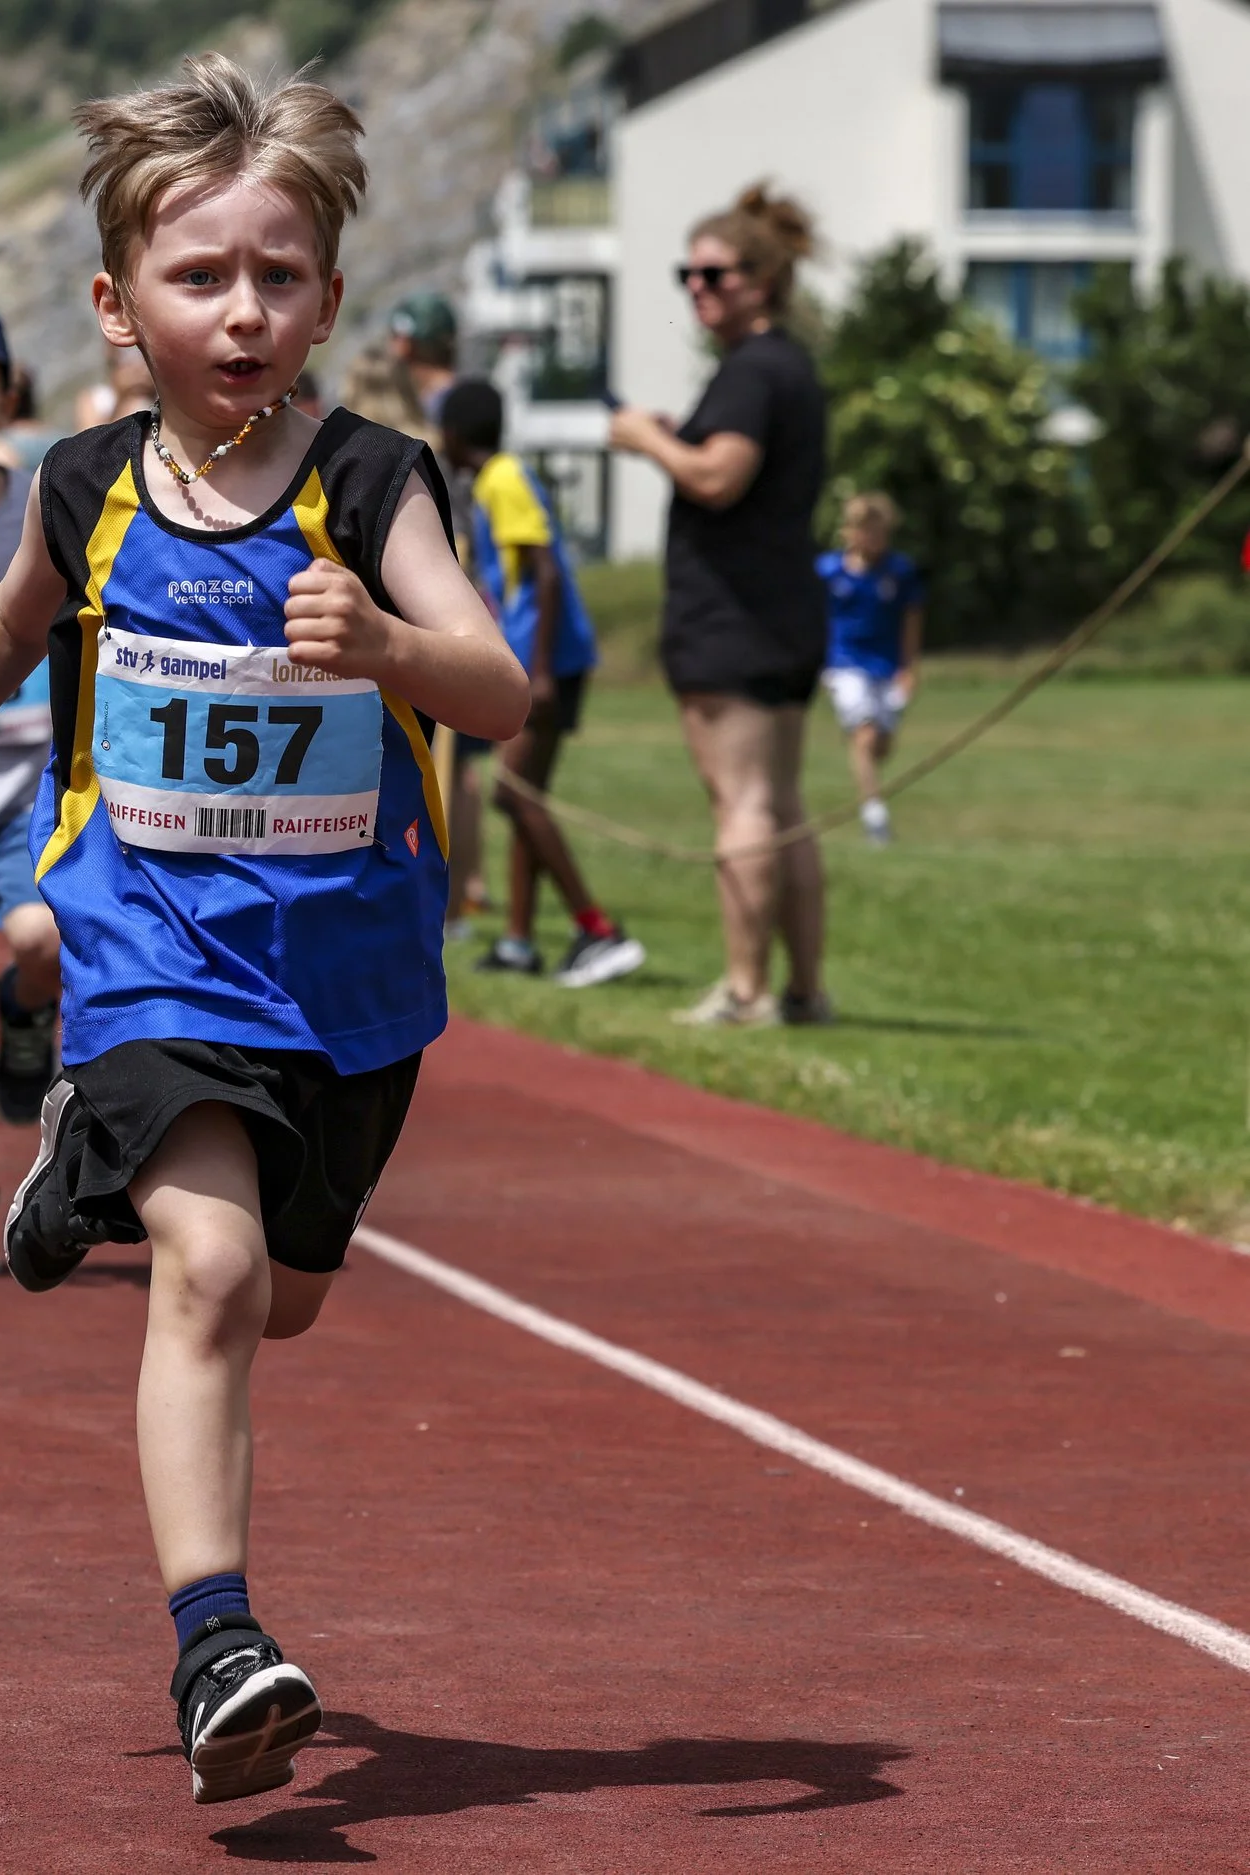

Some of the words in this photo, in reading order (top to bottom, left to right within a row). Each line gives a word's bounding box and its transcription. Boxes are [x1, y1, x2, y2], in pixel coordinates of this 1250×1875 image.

[168, 576, 253, 597] panzeri
[174, 594, 207, 604] veste
[210, 594, 220, 604] lo
[223, 594, 253, 607] sport
[116, 647, 138, 668] stv
[161, 659, 227, 680] gampel
[150, 698, 323, 785] 157
[105, 798, 186, 830] AIFFEISEN
[273, 814, 368, 834] RAIFFEISEN
